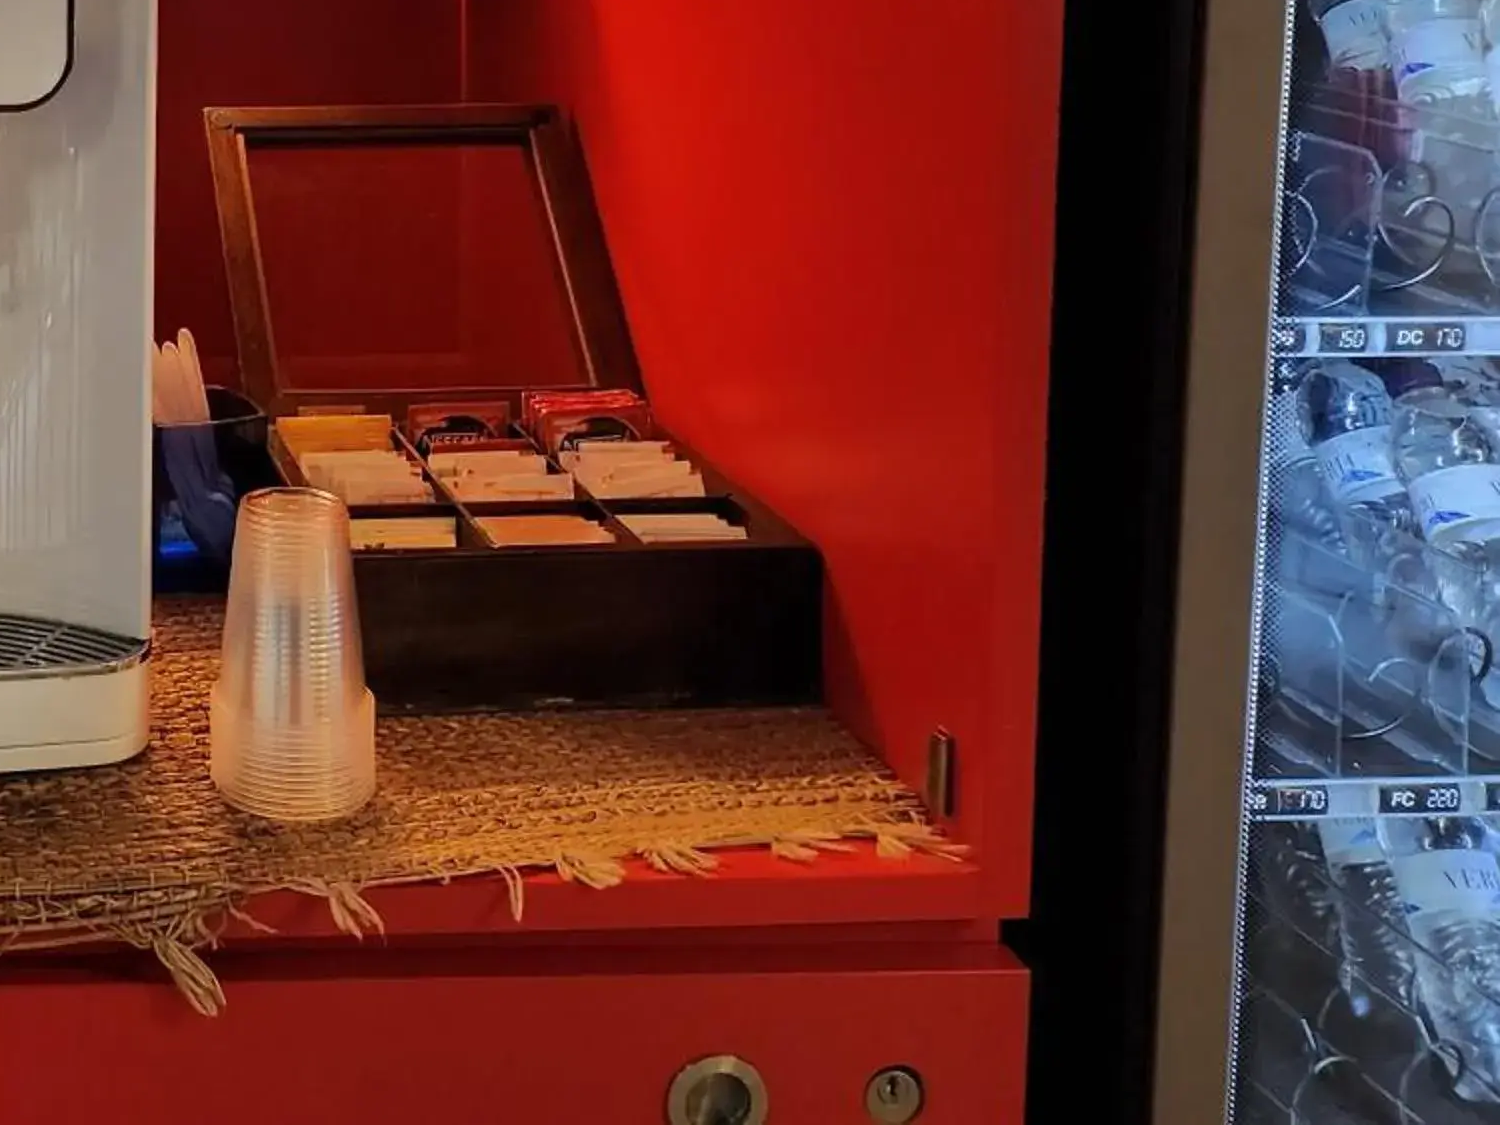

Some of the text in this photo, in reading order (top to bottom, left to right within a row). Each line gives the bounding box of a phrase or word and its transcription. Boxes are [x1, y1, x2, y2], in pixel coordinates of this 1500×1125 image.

[1397, 330, 1424, 345] DC
[1391, 789, 1458, 808] FC 220
